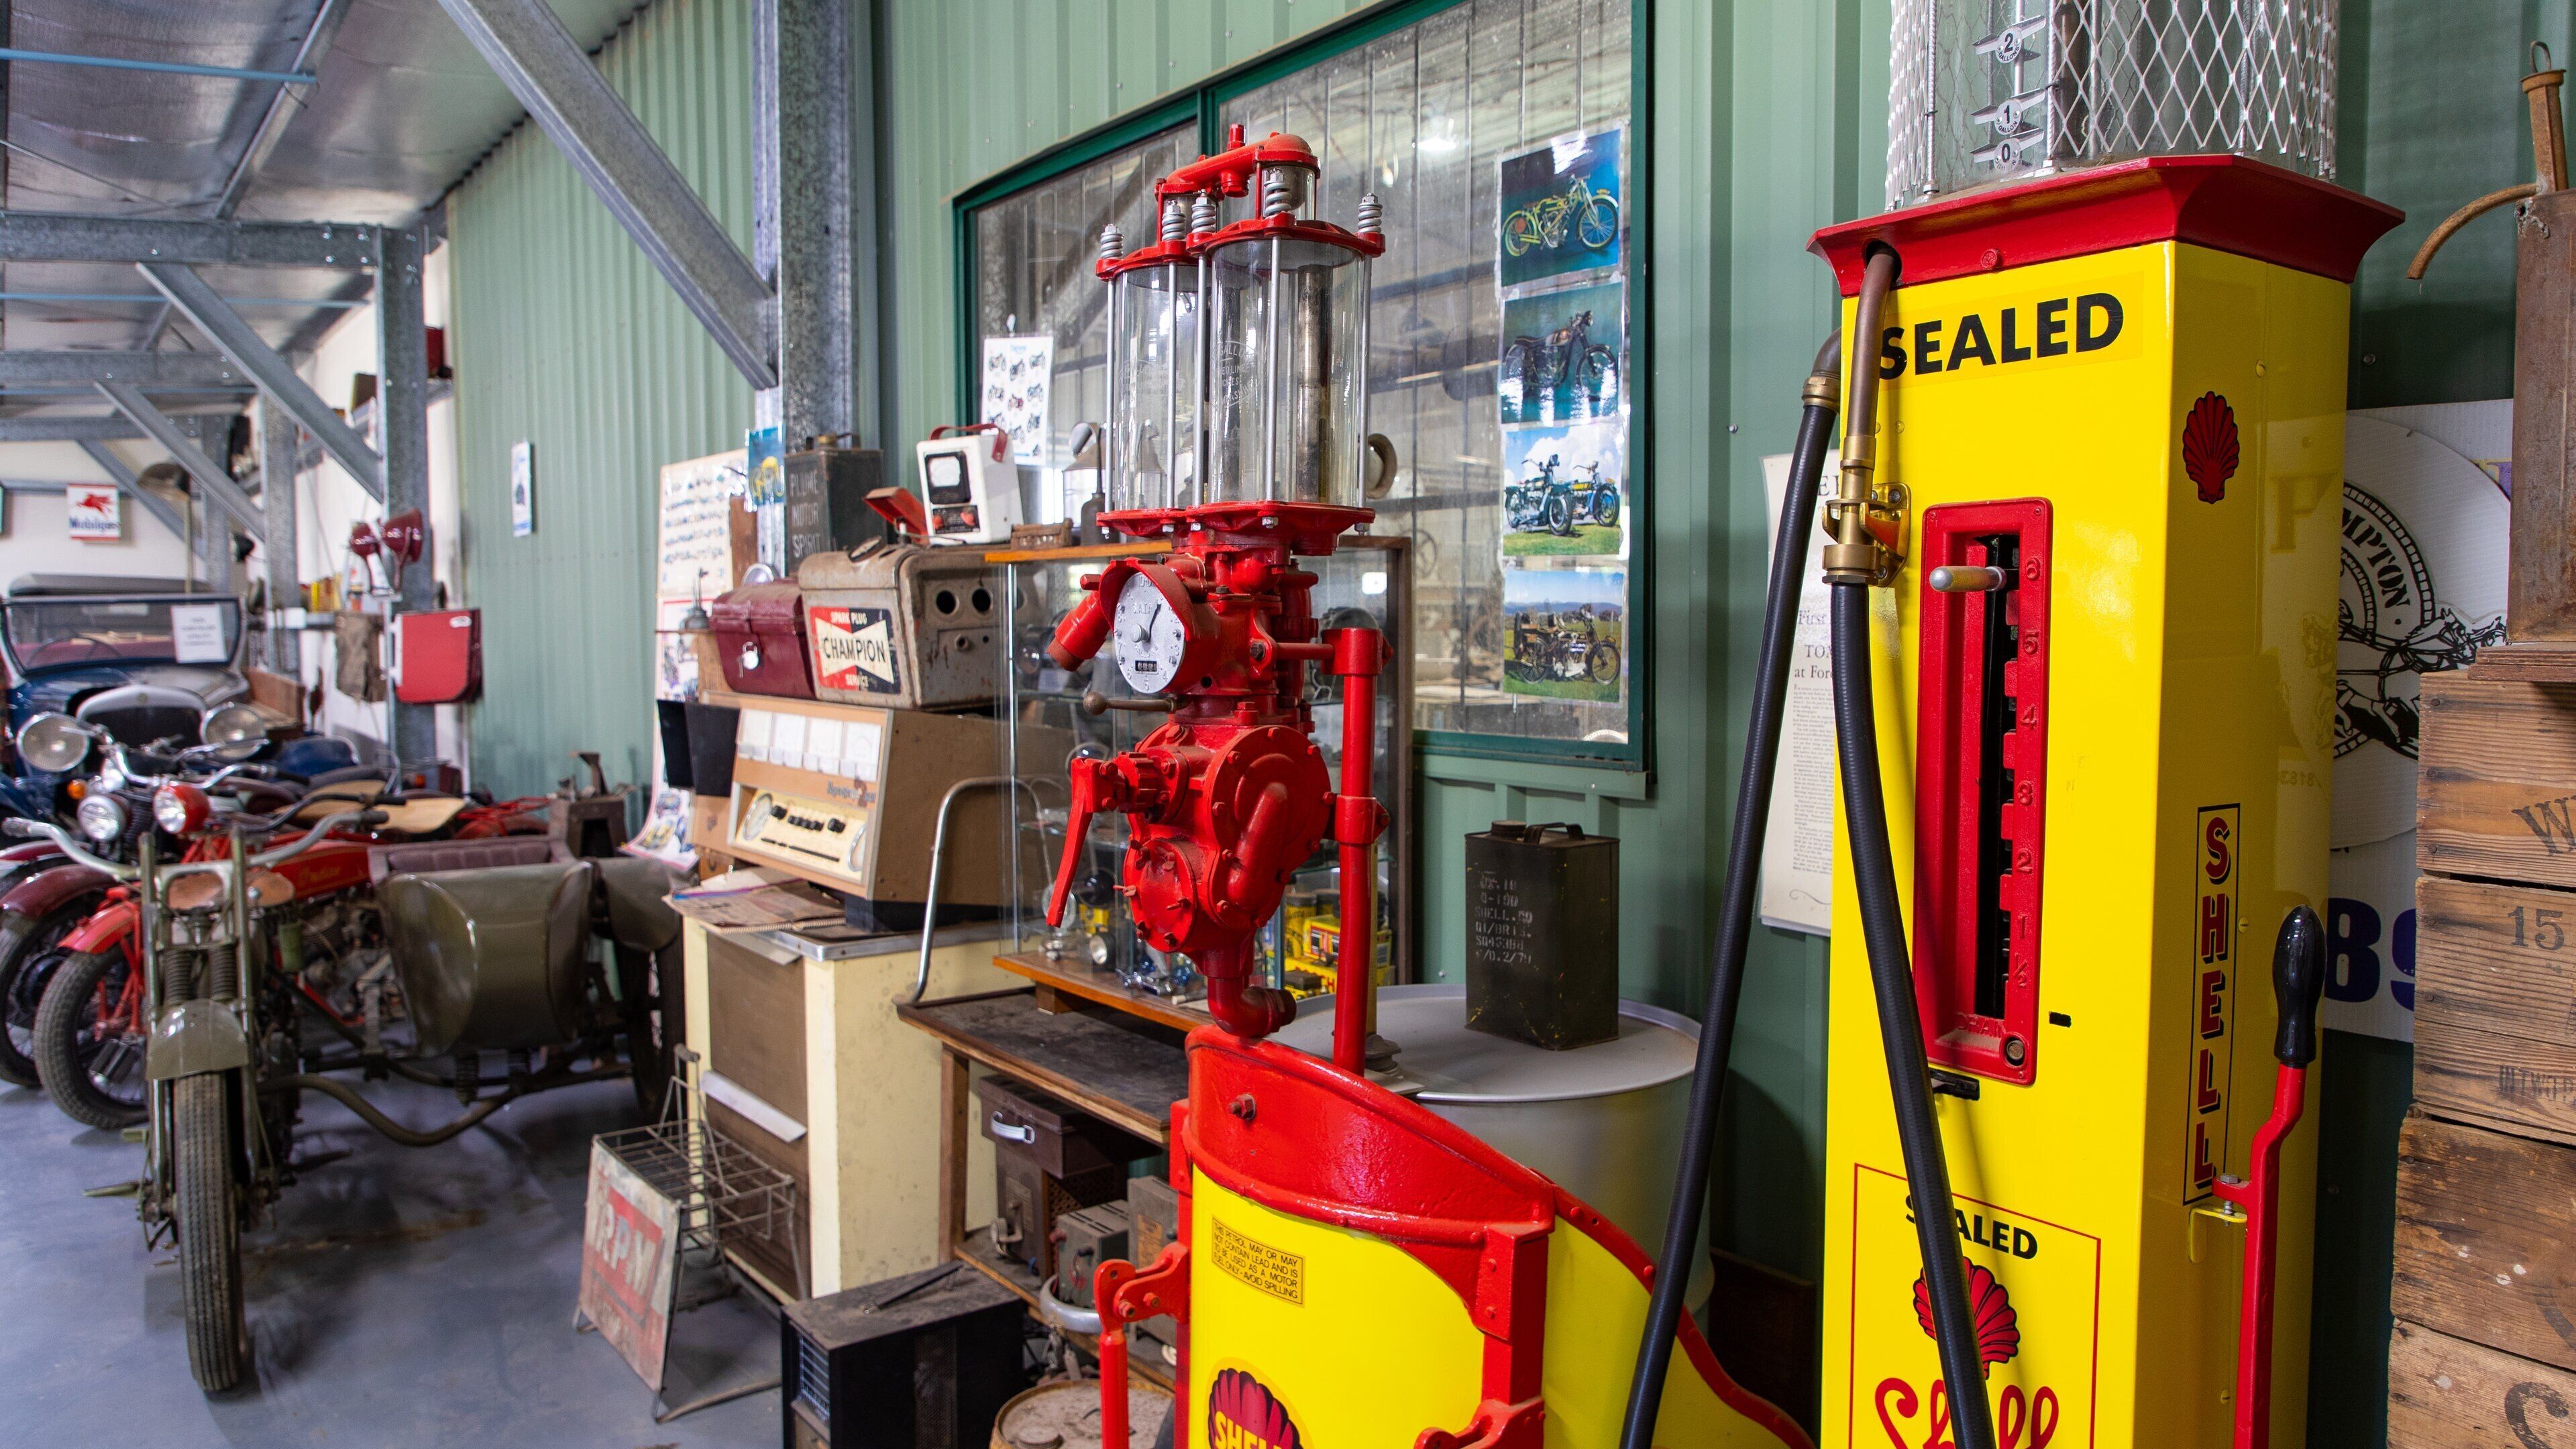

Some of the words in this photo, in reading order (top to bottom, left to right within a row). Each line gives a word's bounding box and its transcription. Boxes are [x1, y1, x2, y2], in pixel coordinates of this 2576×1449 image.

[1998, 46, 2019, 62] GALLONS
[2004, 32, 2013, 53] 2
[1998, 121, 2018, 133] GALLON
[2003, 104, 2010, 124] 1
[2001, 143, 2010, 163] 0
[1880, 292, 2125, 380] SEALED
[2026, 557, 2041, 581] 6
[850, 611, 867, 625] PLUG
[822, 637, 886, 663] CHAMPION
[2023, 629, 2039, 655] 5
[1794, 668, 1805, 678] at
[2021, 704, 2037, 731] 4
[2017, 847, 2033, 875] 2
[2017, 913, 2027, 941] 1
[2508, 906, 2565, 951] 15
[2193, 816, 2231, 1190] SHELL
[596, 1202, 657, 1299] RPM
[1214, 1222, 1224, 1236] THIS
[1226, 1230, 1246, 1248] PETROL
[1248, 1242, 1263, 1254] MAY
[1266, 1250, 1277, 1260] OR
[1280, 1254, 1298, 1267] MAY
[1214, 1233, 1224, 1244] NOT
[1224, 1240, 1250, 1260] CONTAIN
[1252, 1255, 1269, 1268] LEAD
[1271, 1263, 1289, 1275] AND
[1290, 1269, 1298, 1279] IS
[1214, 1242, 1221, 1253] TO
[1222, 1248, 1228, 1258] BE
[1230, 1252, 1246, 1268] USED
[1248, 1264, 1258, 1274] AS
[1260, 1269, 1266, 1277] A
[1269, 1271, 1298, 1288] MOTOR
[1214, 1252, 1224, 1267] FUEL
[1265, 1280, 1298, 1299] SPILLING
